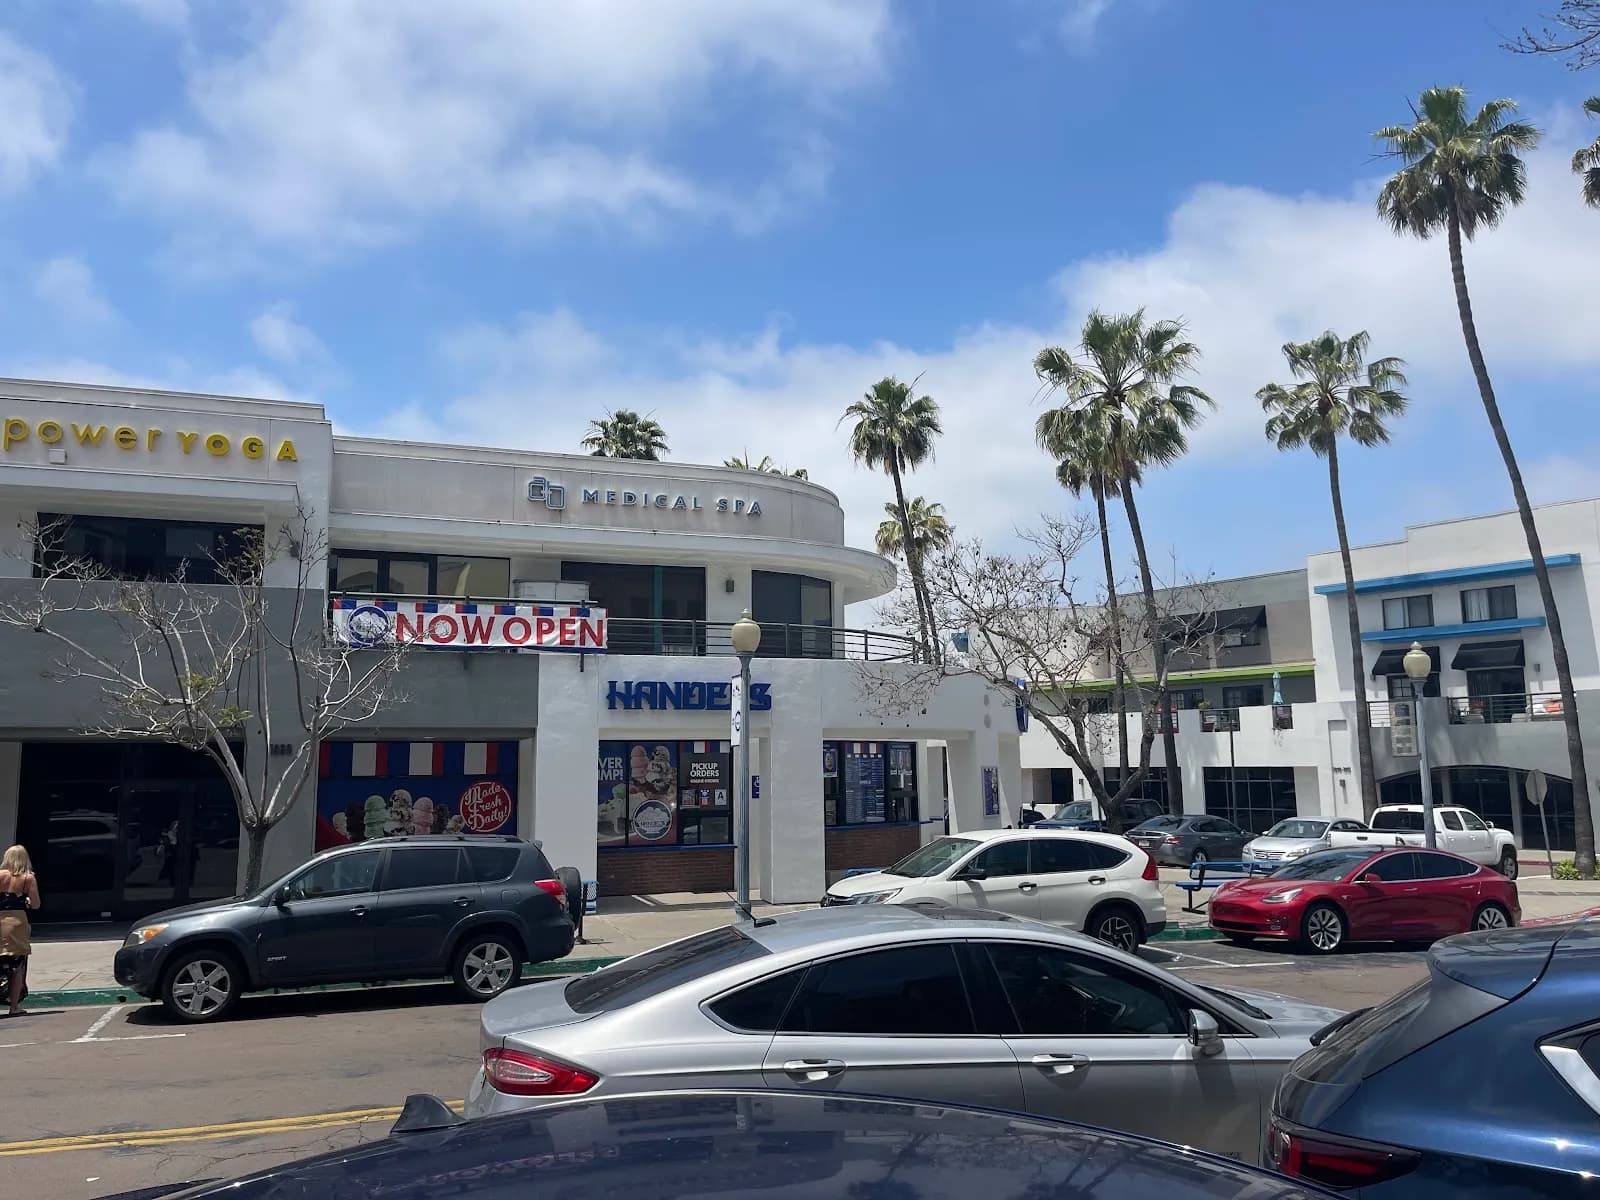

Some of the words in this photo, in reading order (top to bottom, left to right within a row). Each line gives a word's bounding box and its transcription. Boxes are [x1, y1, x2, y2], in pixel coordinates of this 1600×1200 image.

[2, 418, 164, 452] power
[176, 431, 298, 461] YOGA
[582, 488, 703, 511] MEDICAL
[716, 497, 762, 515] SPA
[395, 612, 495, 645] NOW
[502, 617, 604, 646] OPEN
[464, 782, 502, 806] Made
[468, 795, 503, 816] Fresh
[468, 807, 506, 830] Daily!
